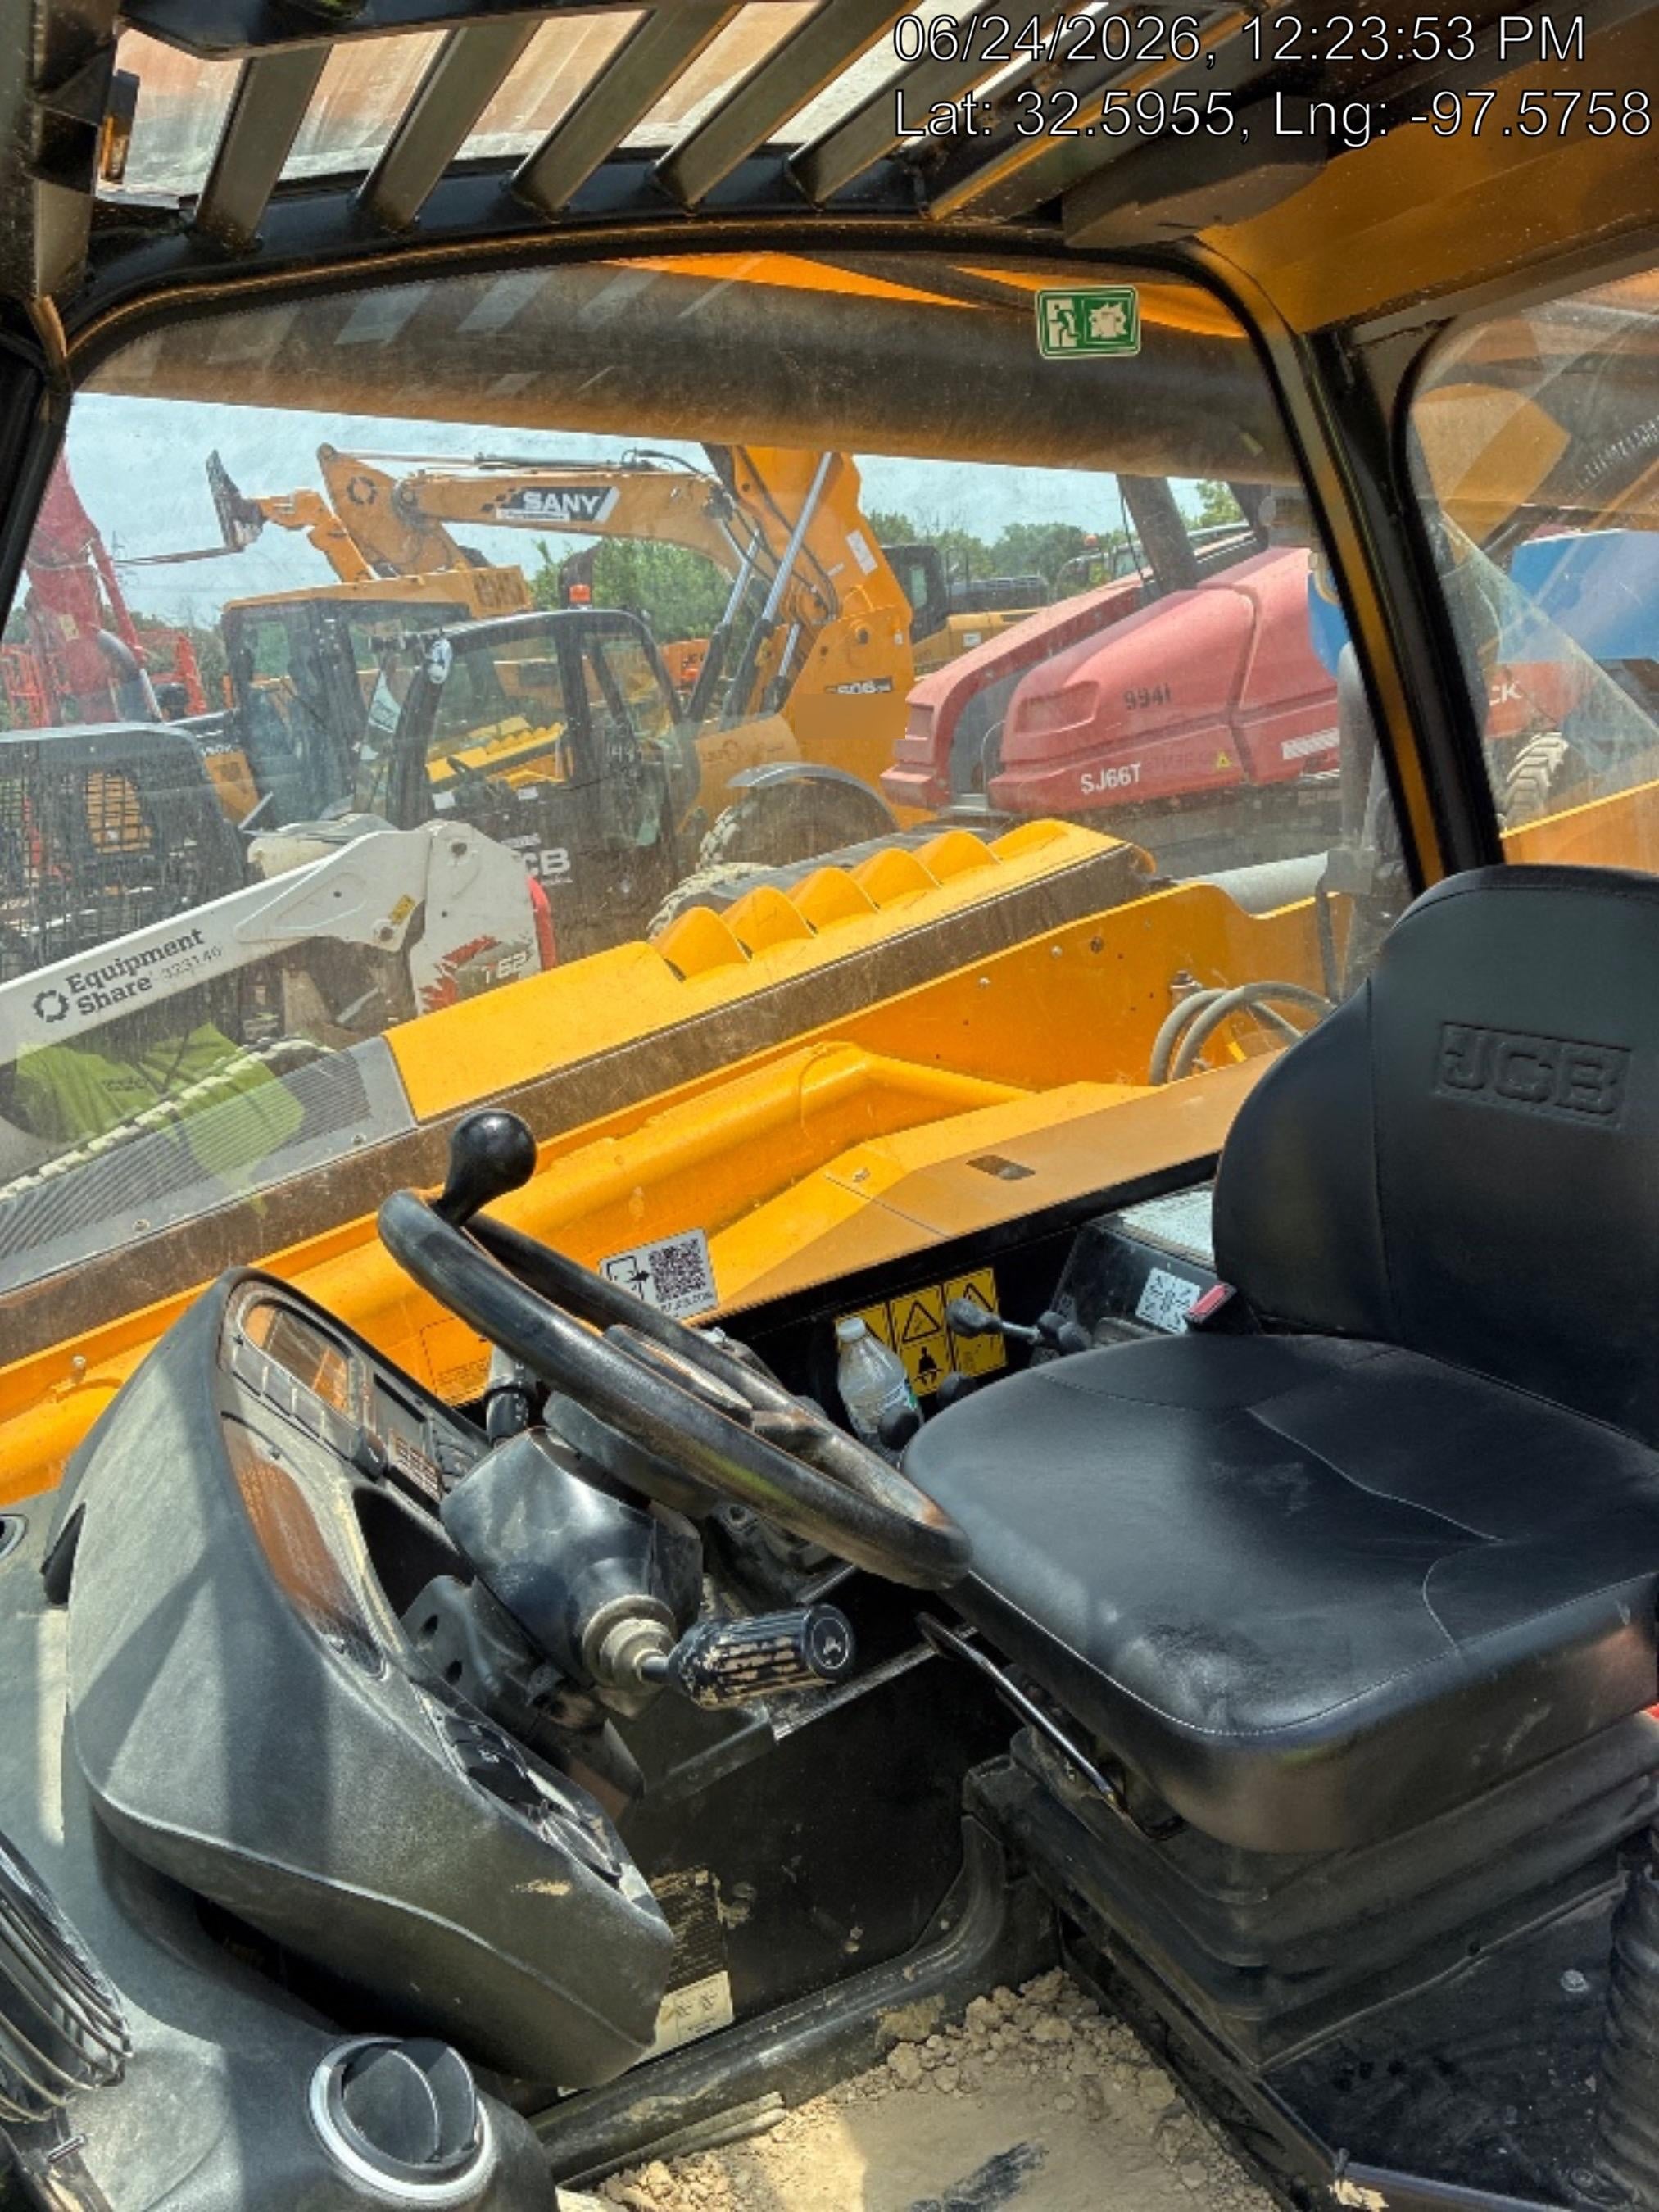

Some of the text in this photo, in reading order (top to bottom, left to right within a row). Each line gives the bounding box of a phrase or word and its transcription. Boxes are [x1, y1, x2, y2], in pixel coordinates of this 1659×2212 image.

[523, 491, 600, 514] SANY
[1081, 762, 1141, 795] SJ66T
[65, 927, 206, 995] Equipment
[76, 974, 154, 1016] Share
[1440, 1026, 1626, 1116] JCB
